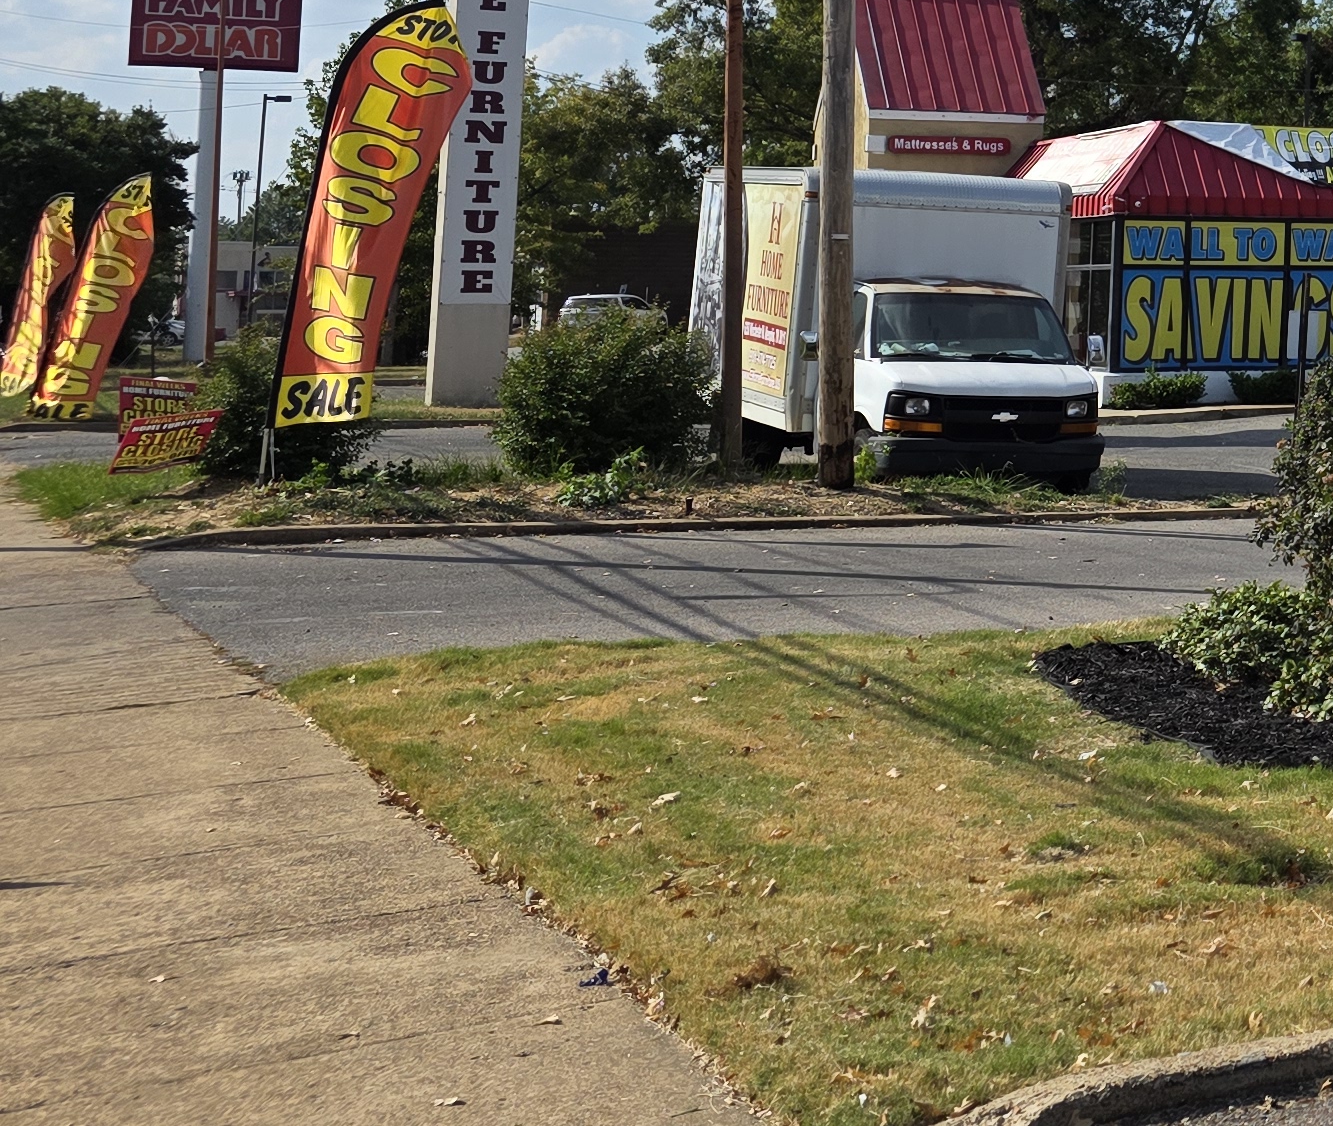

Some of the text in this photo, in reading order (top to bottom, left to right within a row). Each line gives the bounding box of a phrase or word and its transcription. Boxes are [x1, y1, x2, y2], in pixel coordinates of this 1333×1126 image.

[142, 21, 282, 60] DOLLAR
[460, 30, 508, 294] FURNITURE
[894, 137, 1004, 153] Mattresses & Rugs
[303, 47, 459, 364] CLOSING
[1126, 226, 1225, 261] WALL
[1233, 227, 1278, 262] TO
[760, 249, 784, 280] HOME
[747, 283, 790, 320] FURNITURE
[133, 396, 186, 413] STORE
[281, 376, 366, 419] SALE
[120, 435, 204, 458] CLOSING
[137, 425, 200, 446] STORE
